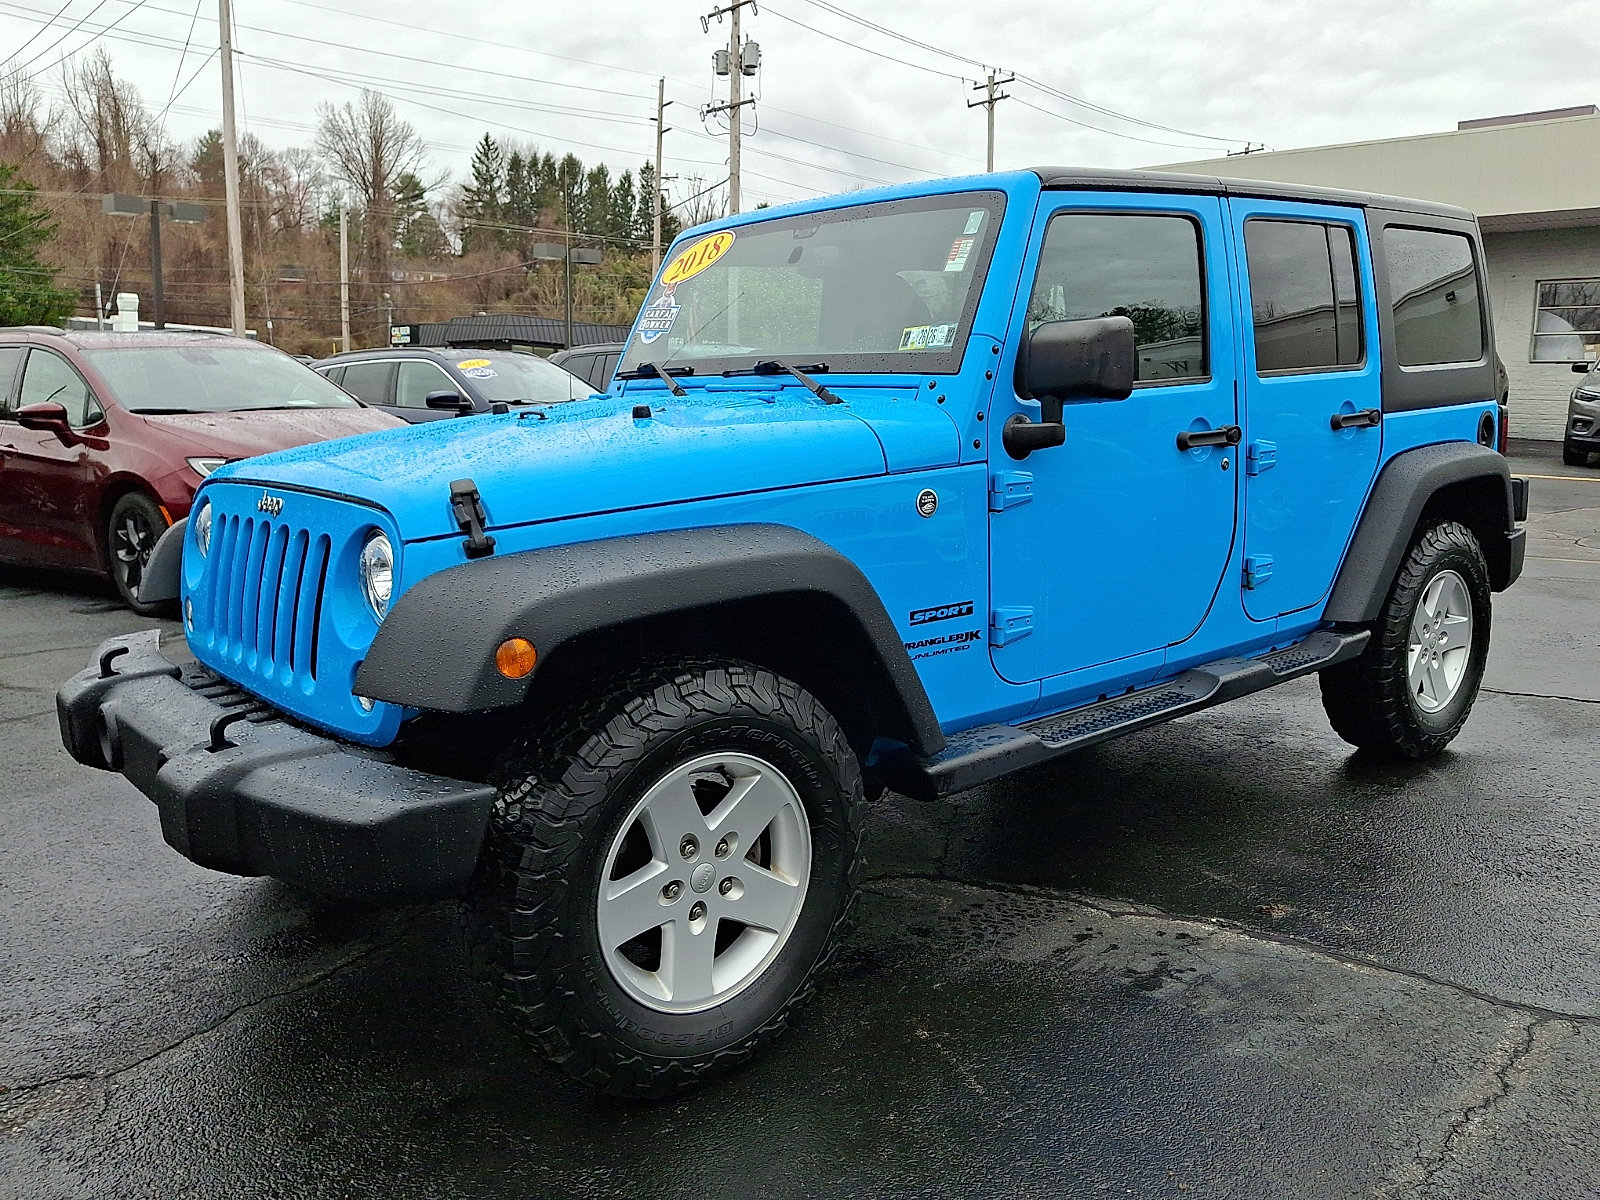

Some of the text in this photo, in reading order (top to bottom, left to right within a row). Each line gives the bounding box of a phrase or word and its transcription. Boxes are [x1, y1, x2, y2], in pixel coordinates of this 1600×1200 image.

[669, 235, 725, 282] 2018
[257, 490, 285, 519] Jeep
[911, 605, 972, 622] SPORT
